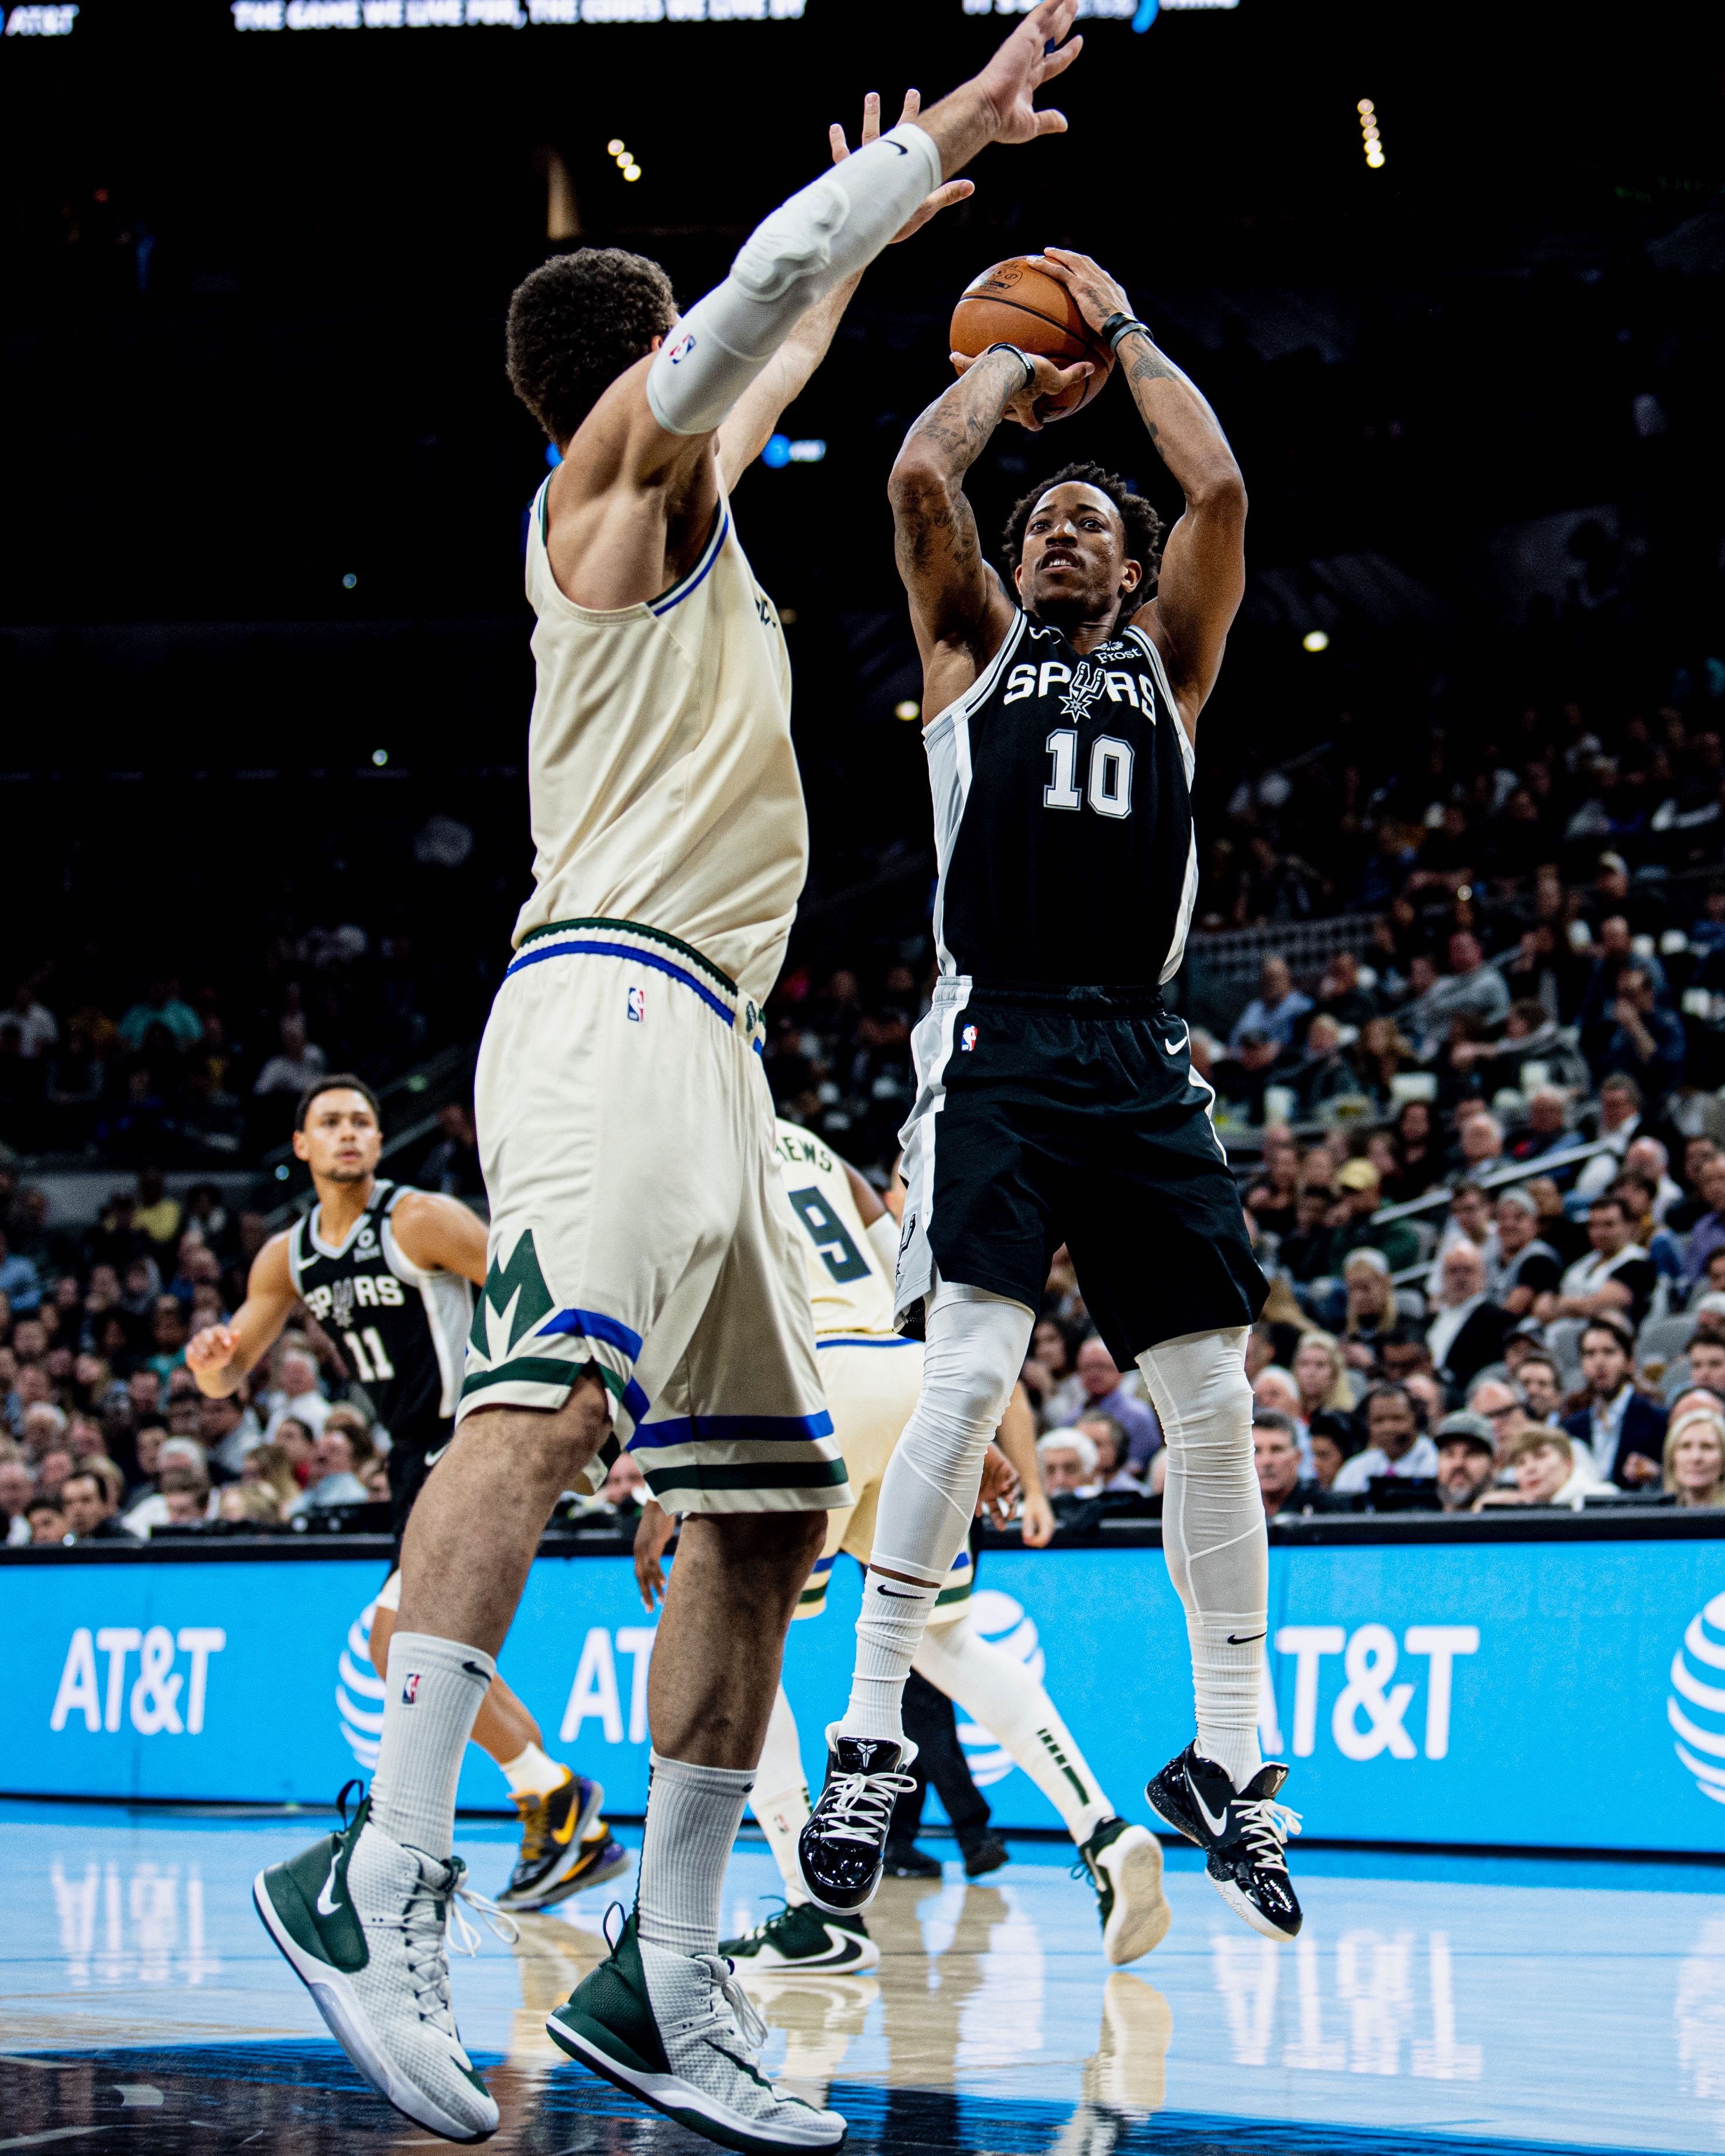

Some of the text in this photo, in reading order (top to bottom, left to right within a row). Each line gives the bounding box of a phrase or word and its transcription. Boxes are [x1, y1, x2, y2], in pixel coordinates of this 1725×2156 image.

[1003, 661, 1157, 726] SPURS
[1095, 646, 1143, 665] Frost
[1043, 727, 1136, 819] 10
[787, 1185, 872, 1283] 9
[304, 1274, 405, 1326] SPURS
[343, 1326, 396, 1382] 11
[50, 1626, 227, 1736] AT&T
[559, 1626, 657, 1744] AT
